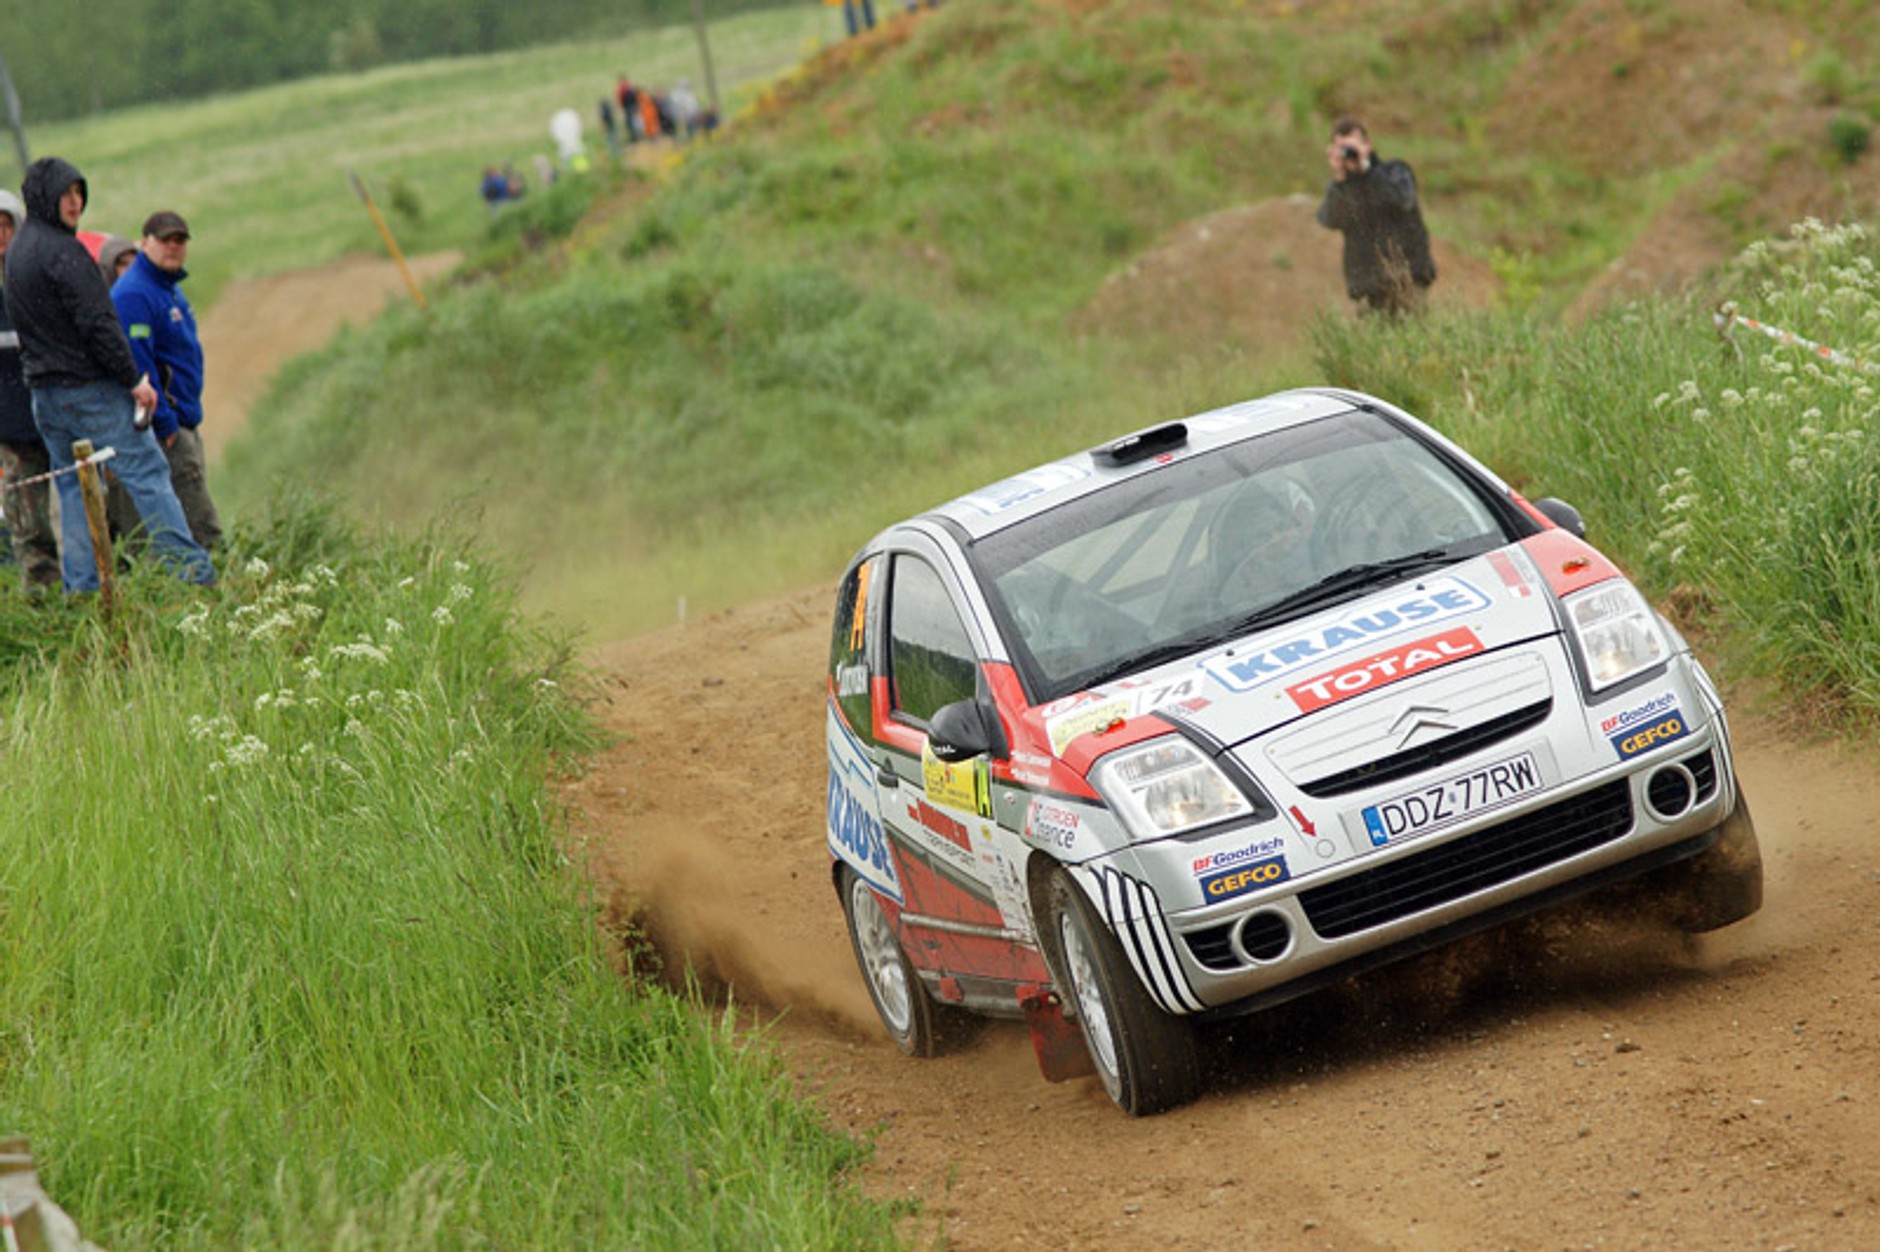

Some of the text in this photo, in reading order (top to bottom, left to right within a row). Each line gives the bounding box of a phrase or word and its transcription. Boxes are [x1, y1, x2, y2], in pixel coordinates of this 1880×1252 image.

[1226, 589, 1475, 683] KRAUSE
[1296, 639, 1475, 700] TOTAL
[1151, 679, 1193, 706] 74
[1600, 692, 1676, 733] BFGoodrich
[1621, 718, 1682, 753] GEFCO
[1193, 836, 1285, 873] BFGoodrich
[1208, 863, 1282, 895] GEFCO
